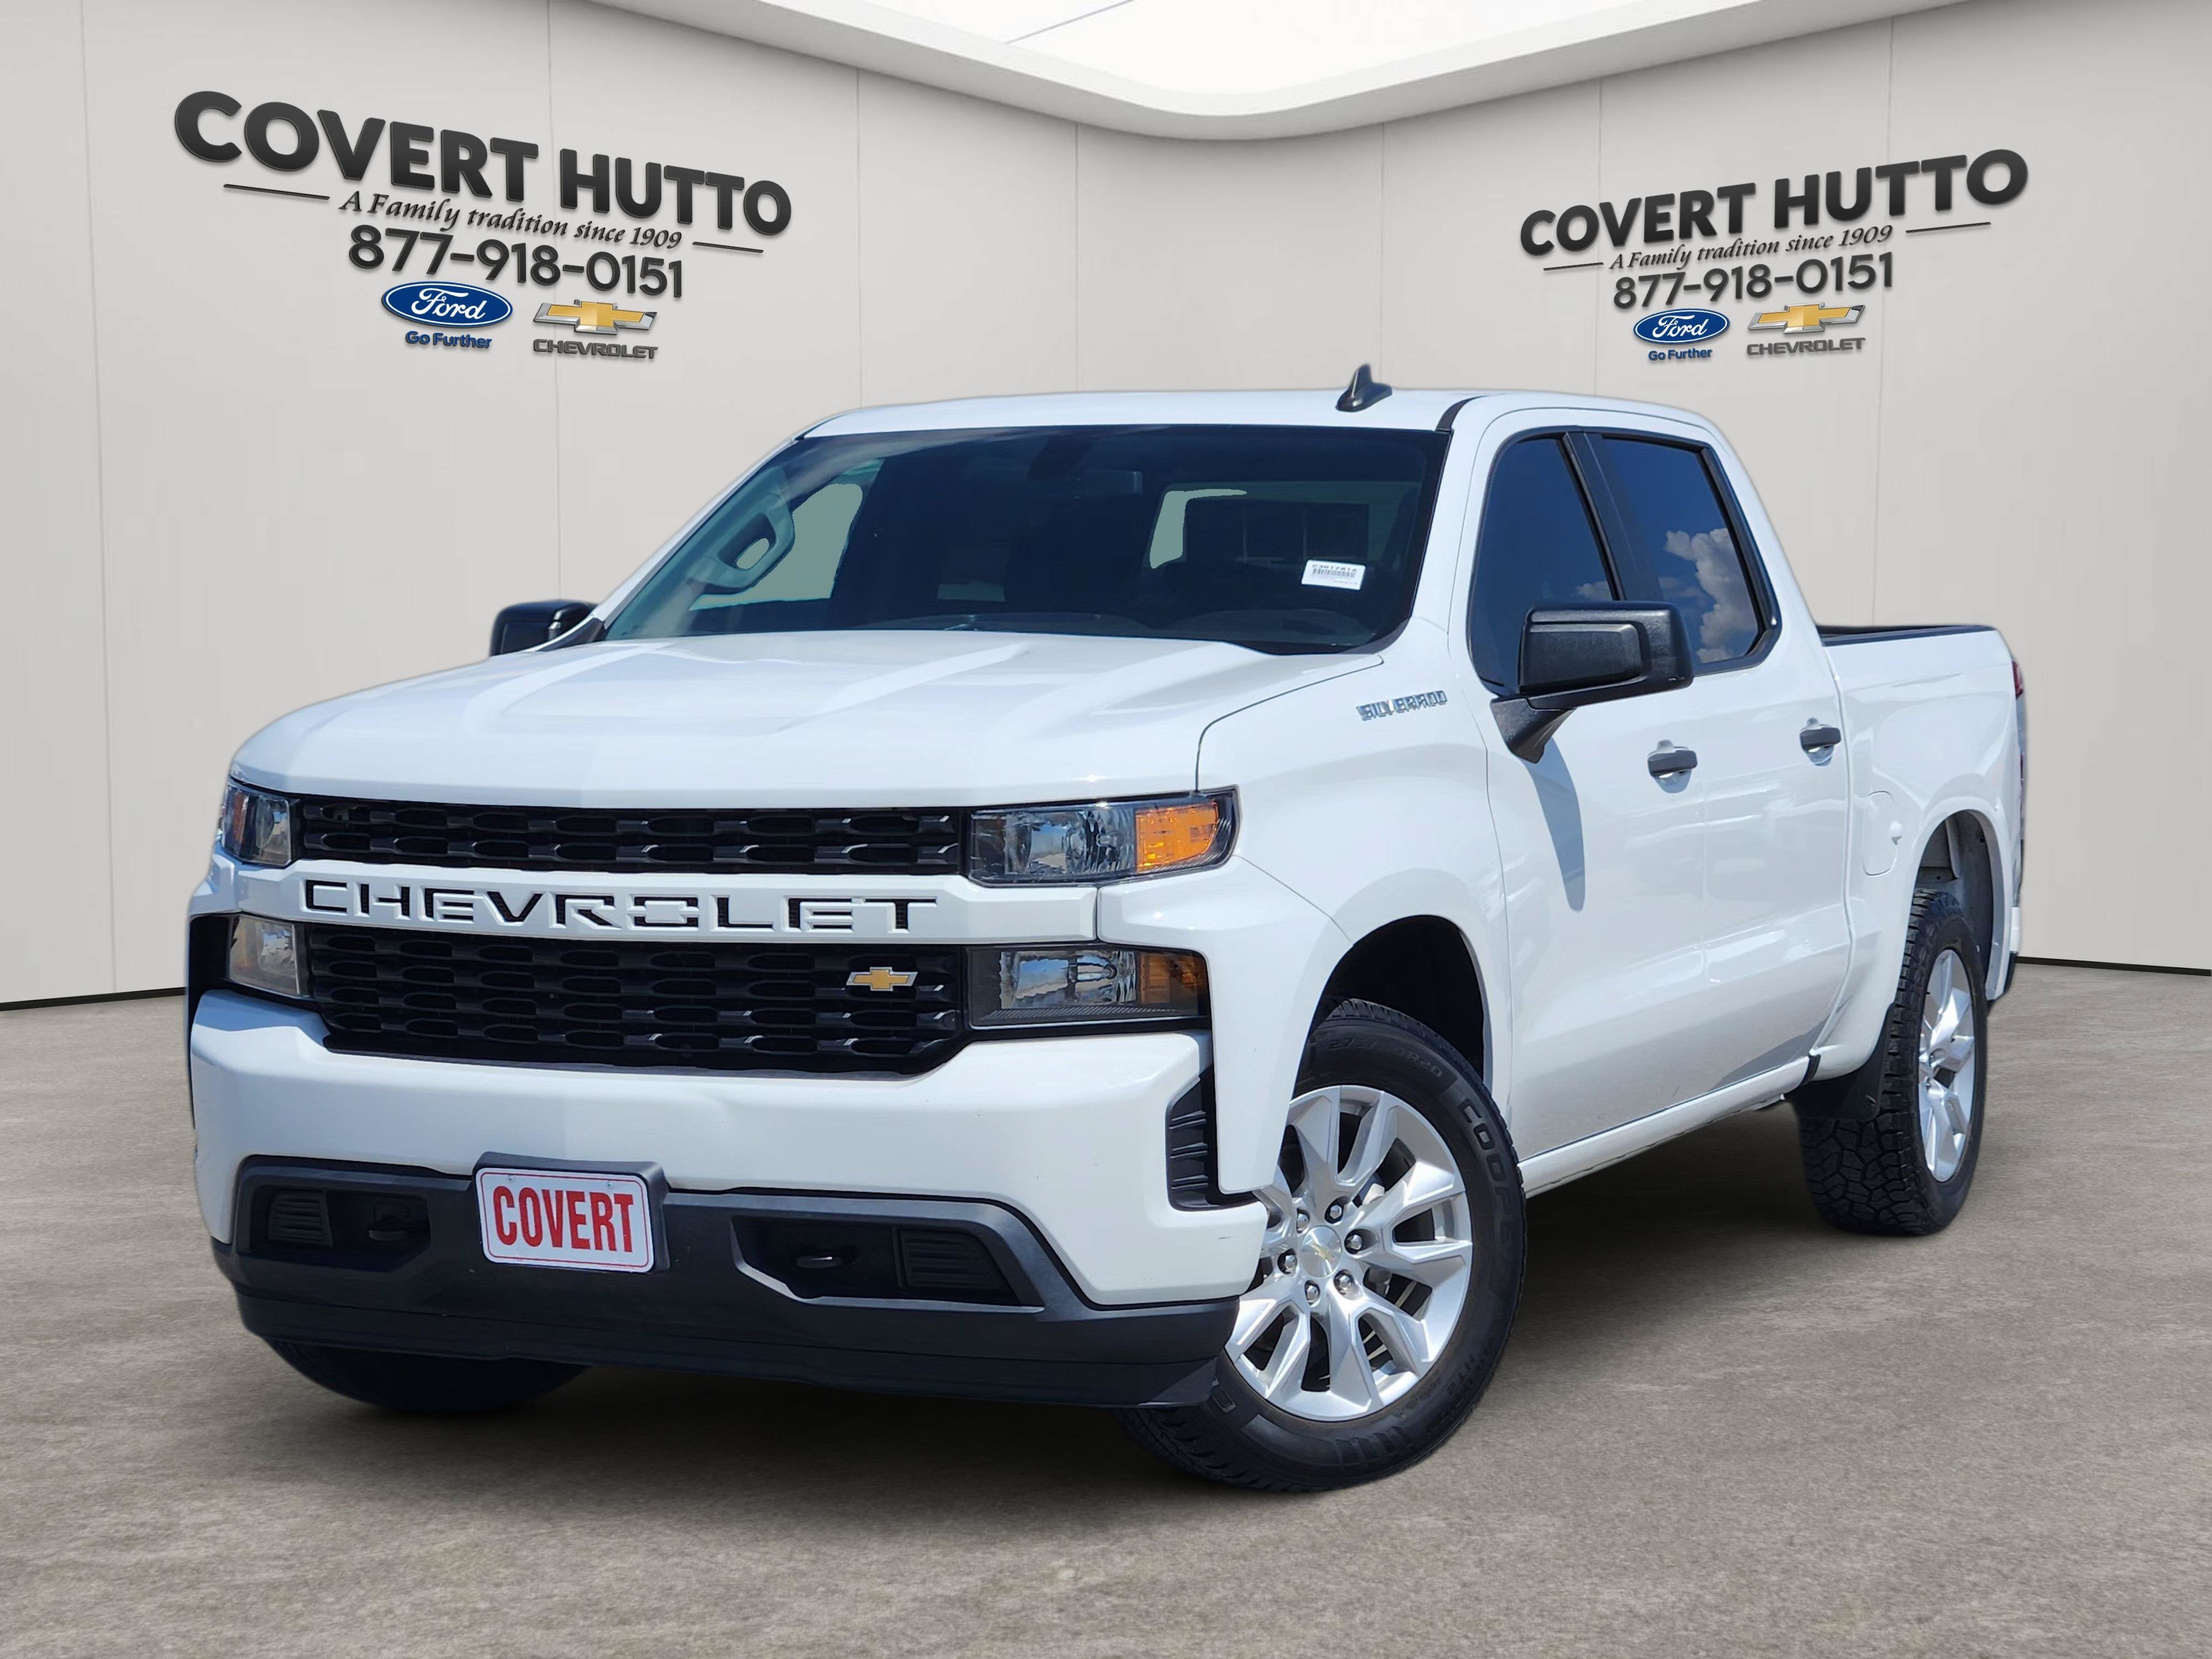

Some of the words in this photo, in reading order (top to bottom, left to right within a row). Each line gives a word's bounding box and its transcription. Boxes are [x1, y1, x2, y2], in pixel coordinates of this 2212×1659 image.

[175, 91, 539, 202] COVERT
[560, 148, 791, 236] HUTTO
[338, 191, 362, 212] A
[366, 193, 460, 232] Family
[467, 208, 568, 236] tradition
[573, 221, 626, 243] since
[629, 227, 682, 249] 1909
[1520, 182, 1756, 257] COVERT
[1774, 149, 2028, 229] HUTTO
[348, 224, 682, 299] 877-918-0151
[1609, 253, 1624, 270] A
[1626, 244, 1692, 270] Family
[1698, 238, 1780, 261] tradition
[1785, 234, 1834, 252] since
[1838, 225, 1893, 247] 1909
[1613, 252, 1893, 309] 877-918-0151
[411, 288, 488, 320] Ford
[1652, 315, 1709, 337] Ford
[405, 331, 431, 346] Go
[433, 332, 492, 349] Further
[533, 338, 659, 359] CHEVROLET
[1648, 349, 1666, 361] Go
[1668, 347, 1713, 359] Further
[1746, 337, 1866, 356] CHEVROLET
[1357, 690, 1448, 721] SILVERADO
[304, 878, 938, 933] CHEVROLET
[493, 1186, 634, 1253] COVERT
